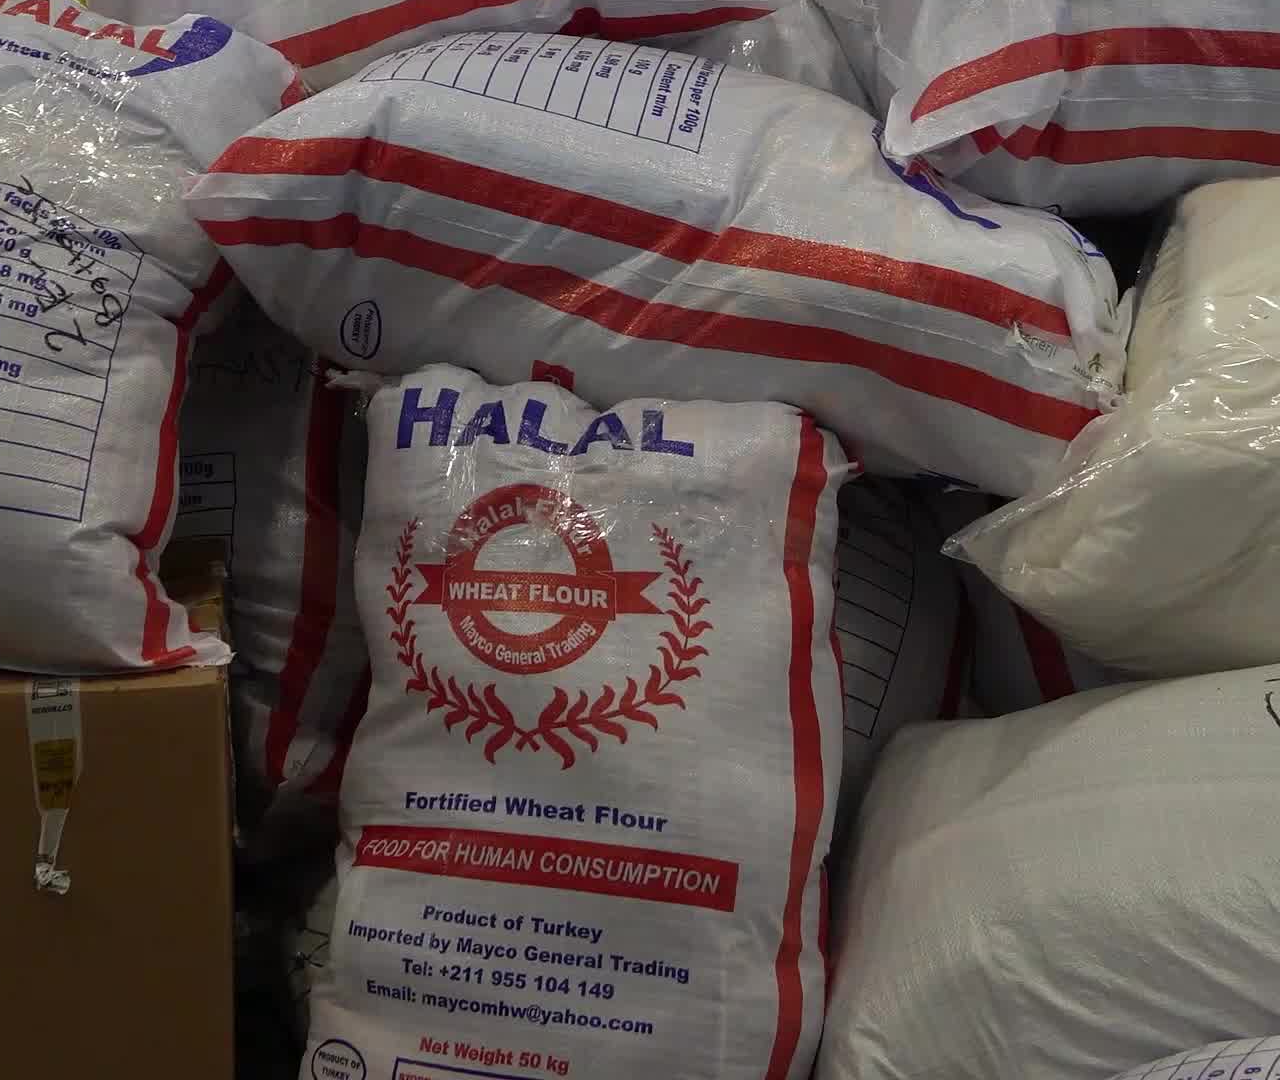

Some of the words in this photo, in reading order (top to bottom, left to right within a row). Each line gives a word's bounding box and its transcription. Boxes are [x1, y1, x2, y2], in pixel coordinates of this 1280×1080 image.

[8, 299, 39, 318] mg
[396, 387, 695, 457] HALAL
[448, 581, 521, 602] WHEAT
[528, 583, 609, 609] FLOUR
[458, 614, 494, 654] Mayco
[495, 648, 546, 666] General
[546, 620, 595, 659] Trading
[405, 791, 497, 814] Fortified
[505, 797, 586, 823] Wheat
[594, 806, 669, 834] Flour
[362, 838, 411, 857] FOOD
[410, 840, 450, 860] FOR
[453, 842, 534, 872] HUMAN
[539, 851, 721, 895] CONSUMPTION
[422, 905, 497, 929] Product
[503, 916, 525, 932] of
[530, 918, 604, 944] Turkey
[348, 920, 425, 948] Imported
[429, 932, 450, 953] by
[455, 936, 517, 961] Mayco
[524, 945, 604, 970] General
[610, 955, 691, 985] Trading
[401, 957, 434, 977] Tel:
[438, 964, 484, 986] +211
[491, 970, 526, 990] 955
[533, 976, 570, 996] 104
[577, 981, 615, 1001] 149
[366, 979, 417, 1003] Email:
[422, 992, 654, 1035] maycomhw@yahoo.com
[419, 1037, 450, 1056] Net
[454, 1042, 514, 1069] Weight
[518, 1050, 544, 1070] 50
[546, 1055, 570, 1076] kg
